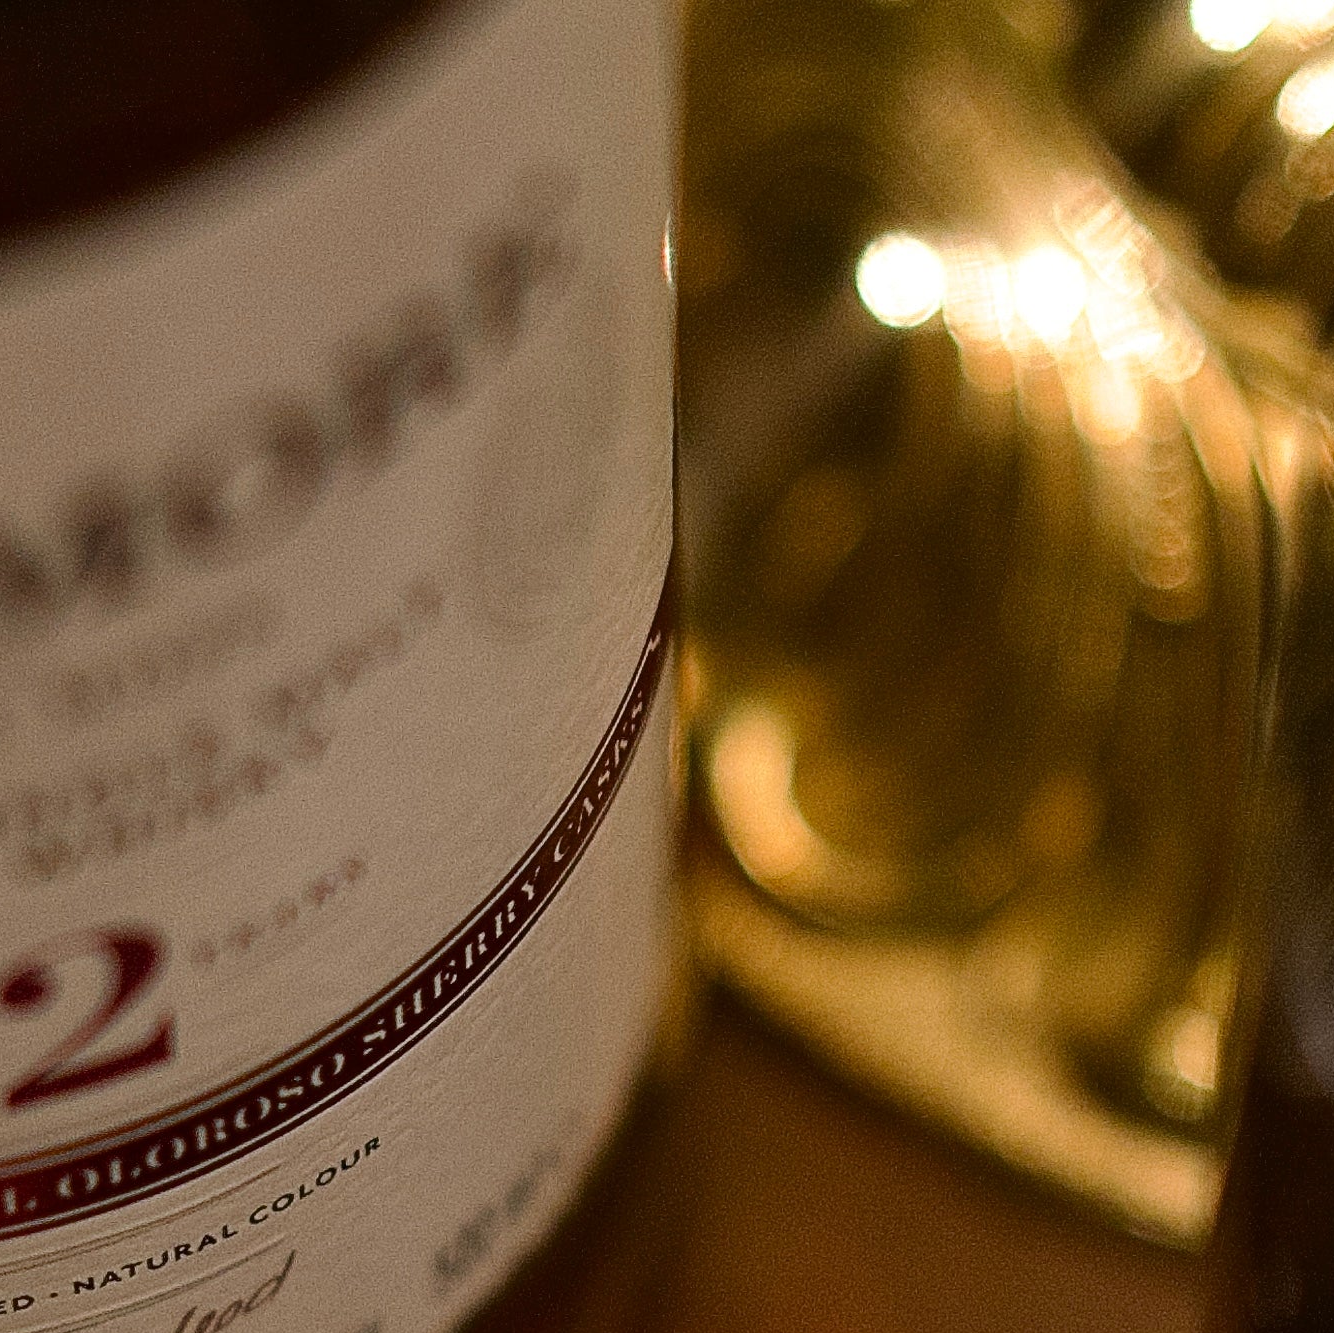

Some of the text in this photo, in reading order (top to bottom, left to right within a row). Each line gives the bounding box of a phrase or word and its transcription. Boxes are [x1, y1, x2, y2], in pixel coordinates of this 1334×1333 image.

[58, 1054, 346, 1200] OLOROSO
[362, 864, 542, 1057] SHERRY
[553, 690, 643, 863] CASKS
[72, 1225, 237, 1296] NATURAL
[249, 1136, 382, 1224] COLOUR
